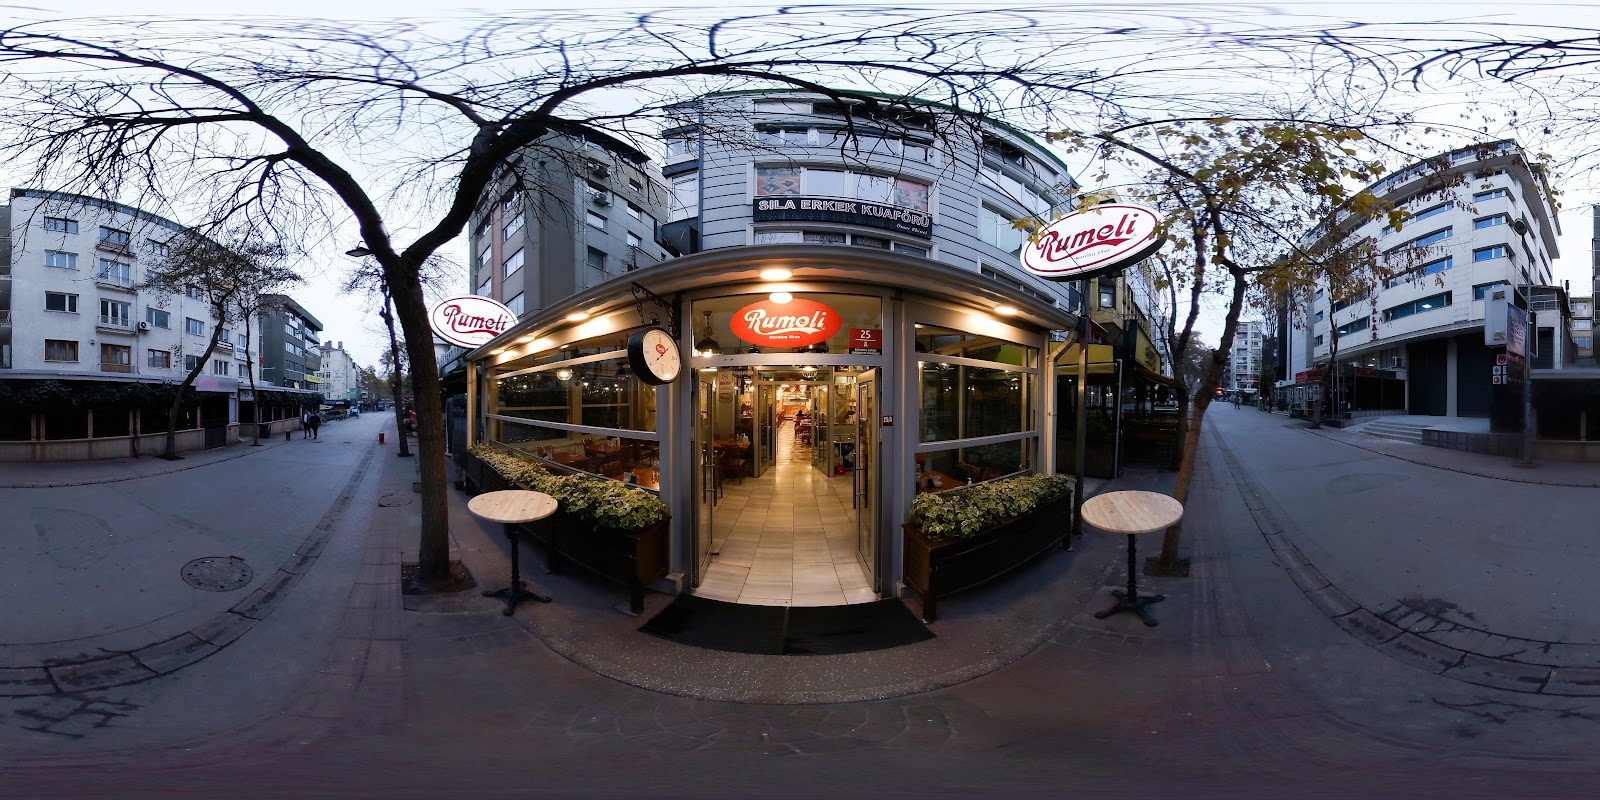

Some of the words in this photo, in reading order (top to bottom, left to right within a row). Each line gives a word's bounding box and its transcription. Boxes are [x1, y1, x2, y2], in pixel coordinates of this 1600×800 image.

[758, 200, 796, 211] SILA
[801, 200, 857, 214] ERKEK
[861, 204, 929, 228] KUAFÖRÜ
[1036, 213, 1139, 262] Rumeli
[443, 304, 508, 336] Rumeli
[744, 309, 827, 334] Rumeli
[860, 329, 871, 339] 25
